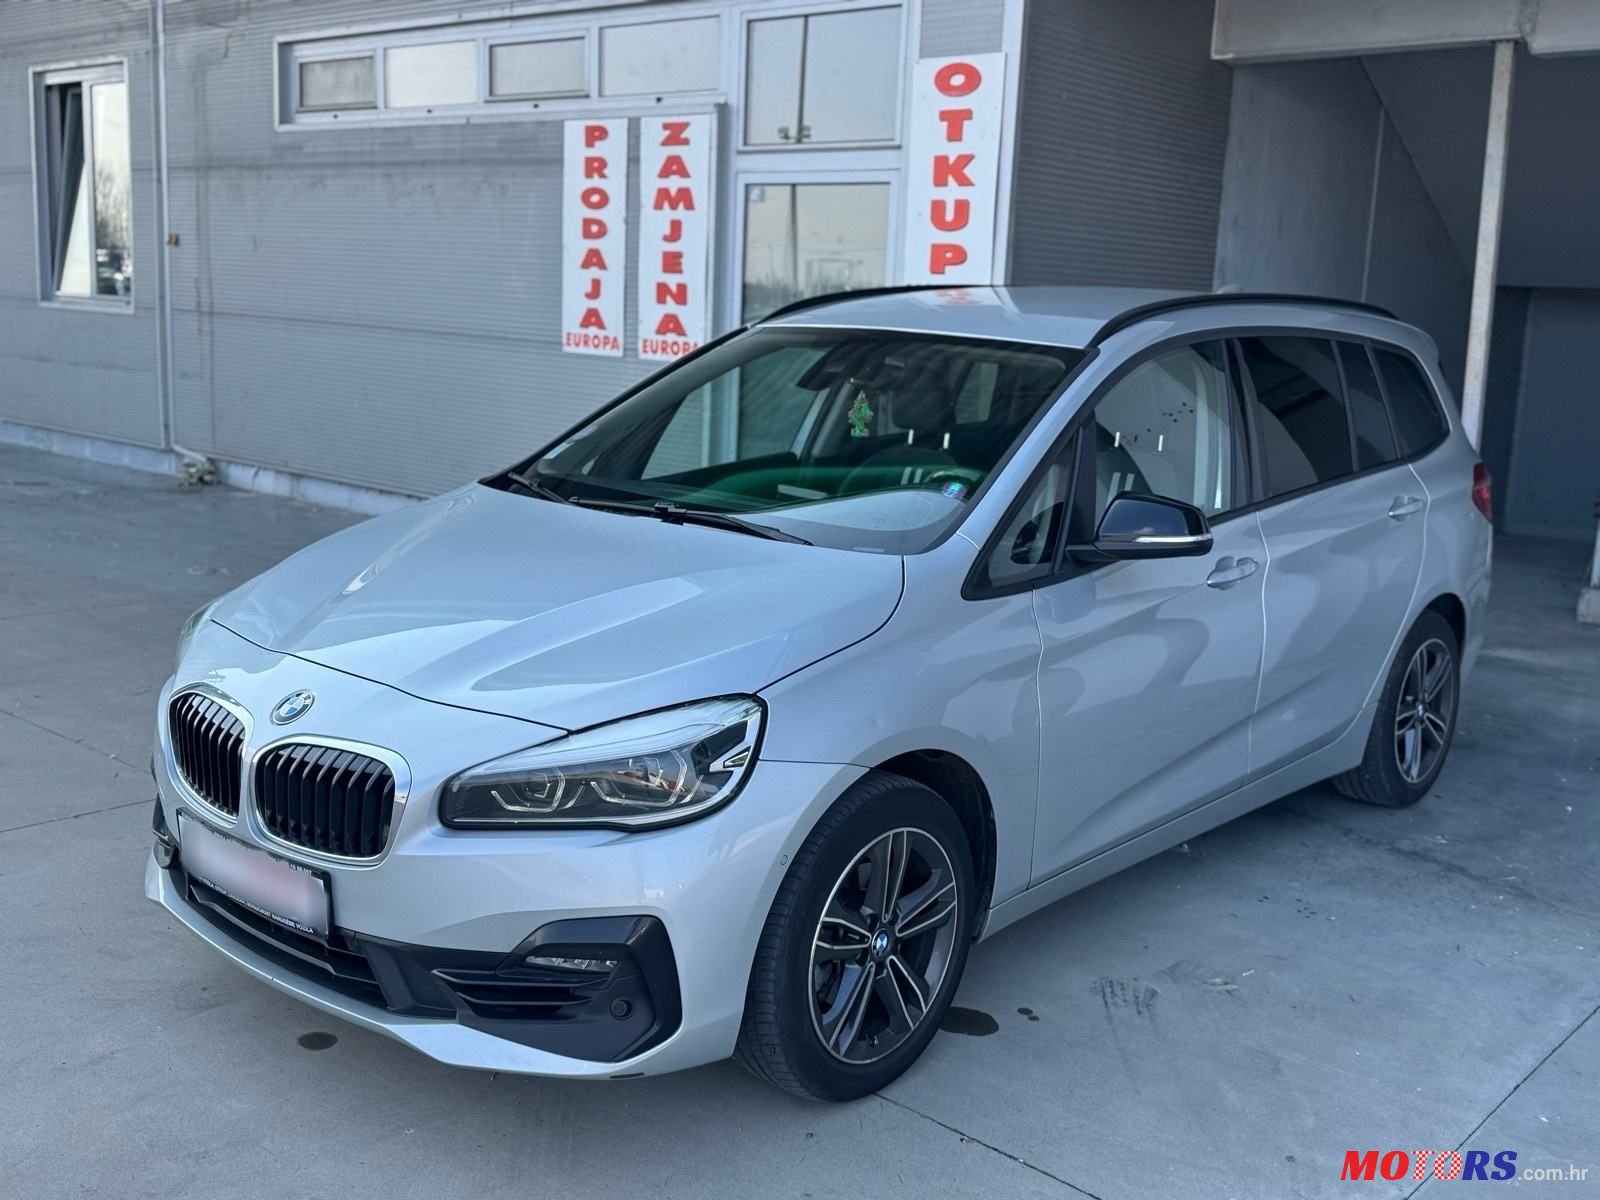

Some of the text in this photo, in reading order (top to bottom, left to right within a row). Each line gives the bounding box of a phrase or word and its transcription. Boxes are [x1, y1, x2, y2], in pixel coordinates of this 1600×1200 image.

[579, 125, 610, 330] PRODAJA
[653, 122, 695, 337] ZAMJENA
[929, 62, 982, 275] OTKUP
[565, 332, 620, 350] EUROPA
